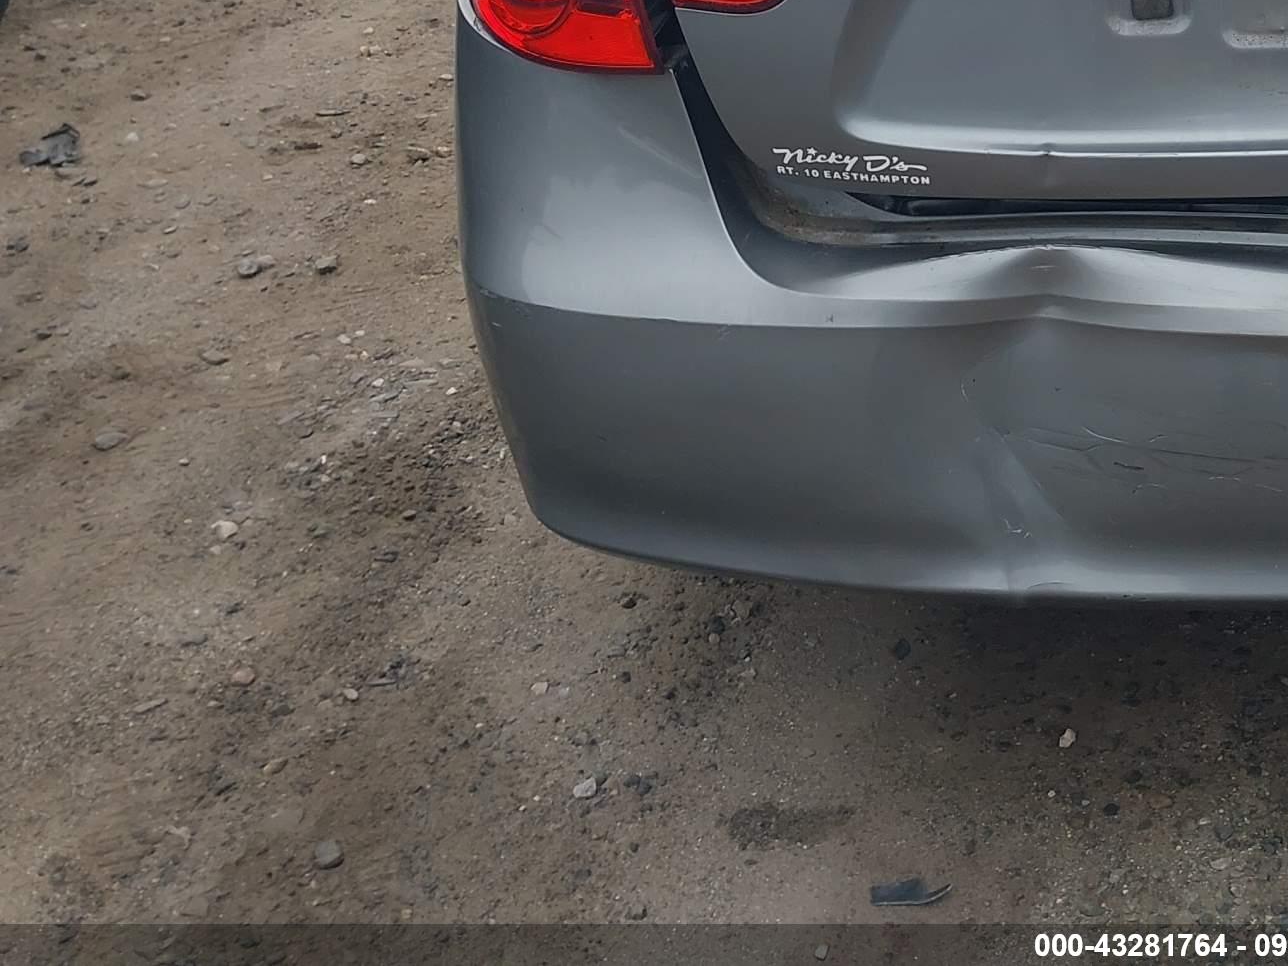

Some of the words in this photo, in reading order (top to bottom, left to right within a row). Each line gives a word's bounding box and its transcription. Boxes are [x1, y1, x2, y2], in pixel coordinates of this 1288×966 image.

[772, 147, 859, 172] Nicky
[862, 155, 928, 173] D's
[776, 165, 800, 177] RT.
[804, 168, 820, 178] 10
[823, 169, 931, 185] EASTHAMPTON
